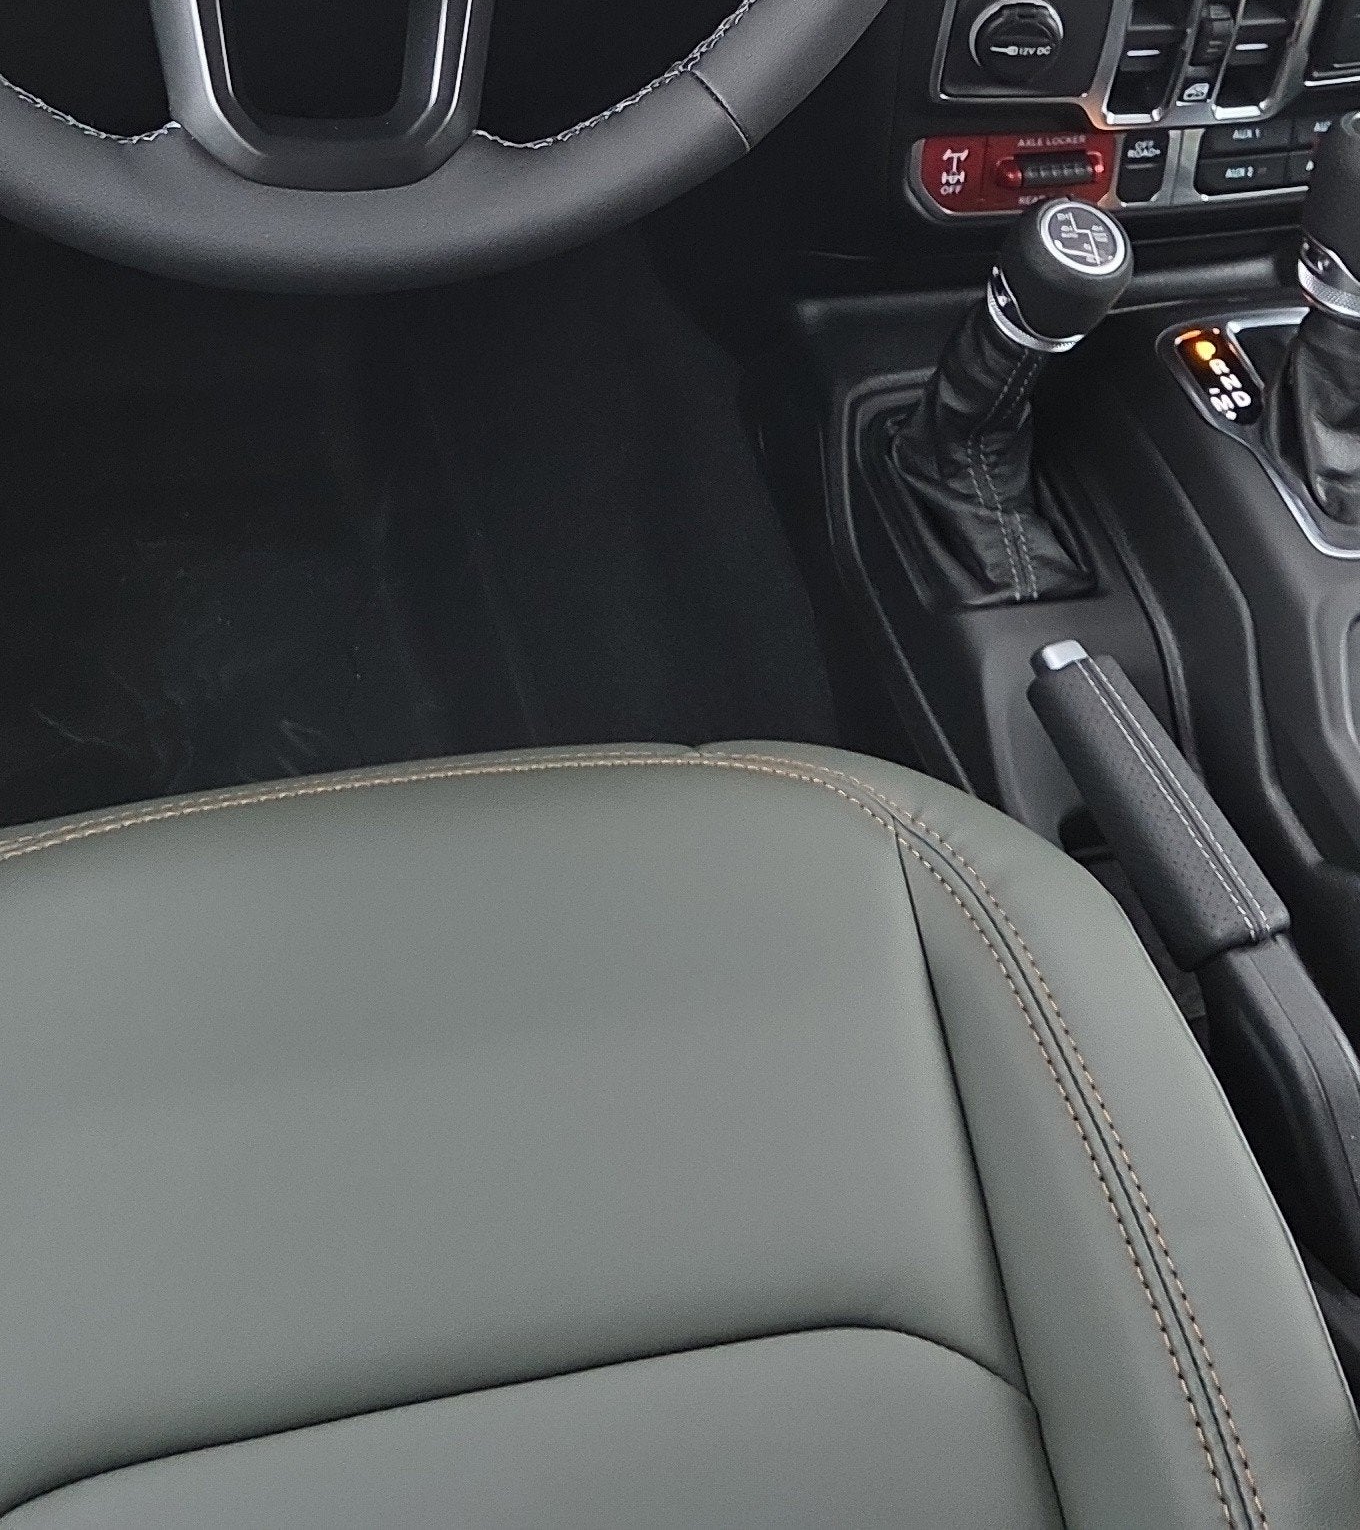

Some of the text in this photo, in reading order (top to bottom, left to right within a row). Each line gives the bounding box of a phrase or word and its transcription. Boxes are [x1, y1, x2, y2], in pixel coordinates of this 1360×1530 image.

[1017, 135, 1086, 147] AXLE LOCKER
[940, 184, 962, 195] OFF
[1208, 358, 1230, 376] R
[1219, 373, 1242, 391] N
[1231, 390, 1252, 408] D
